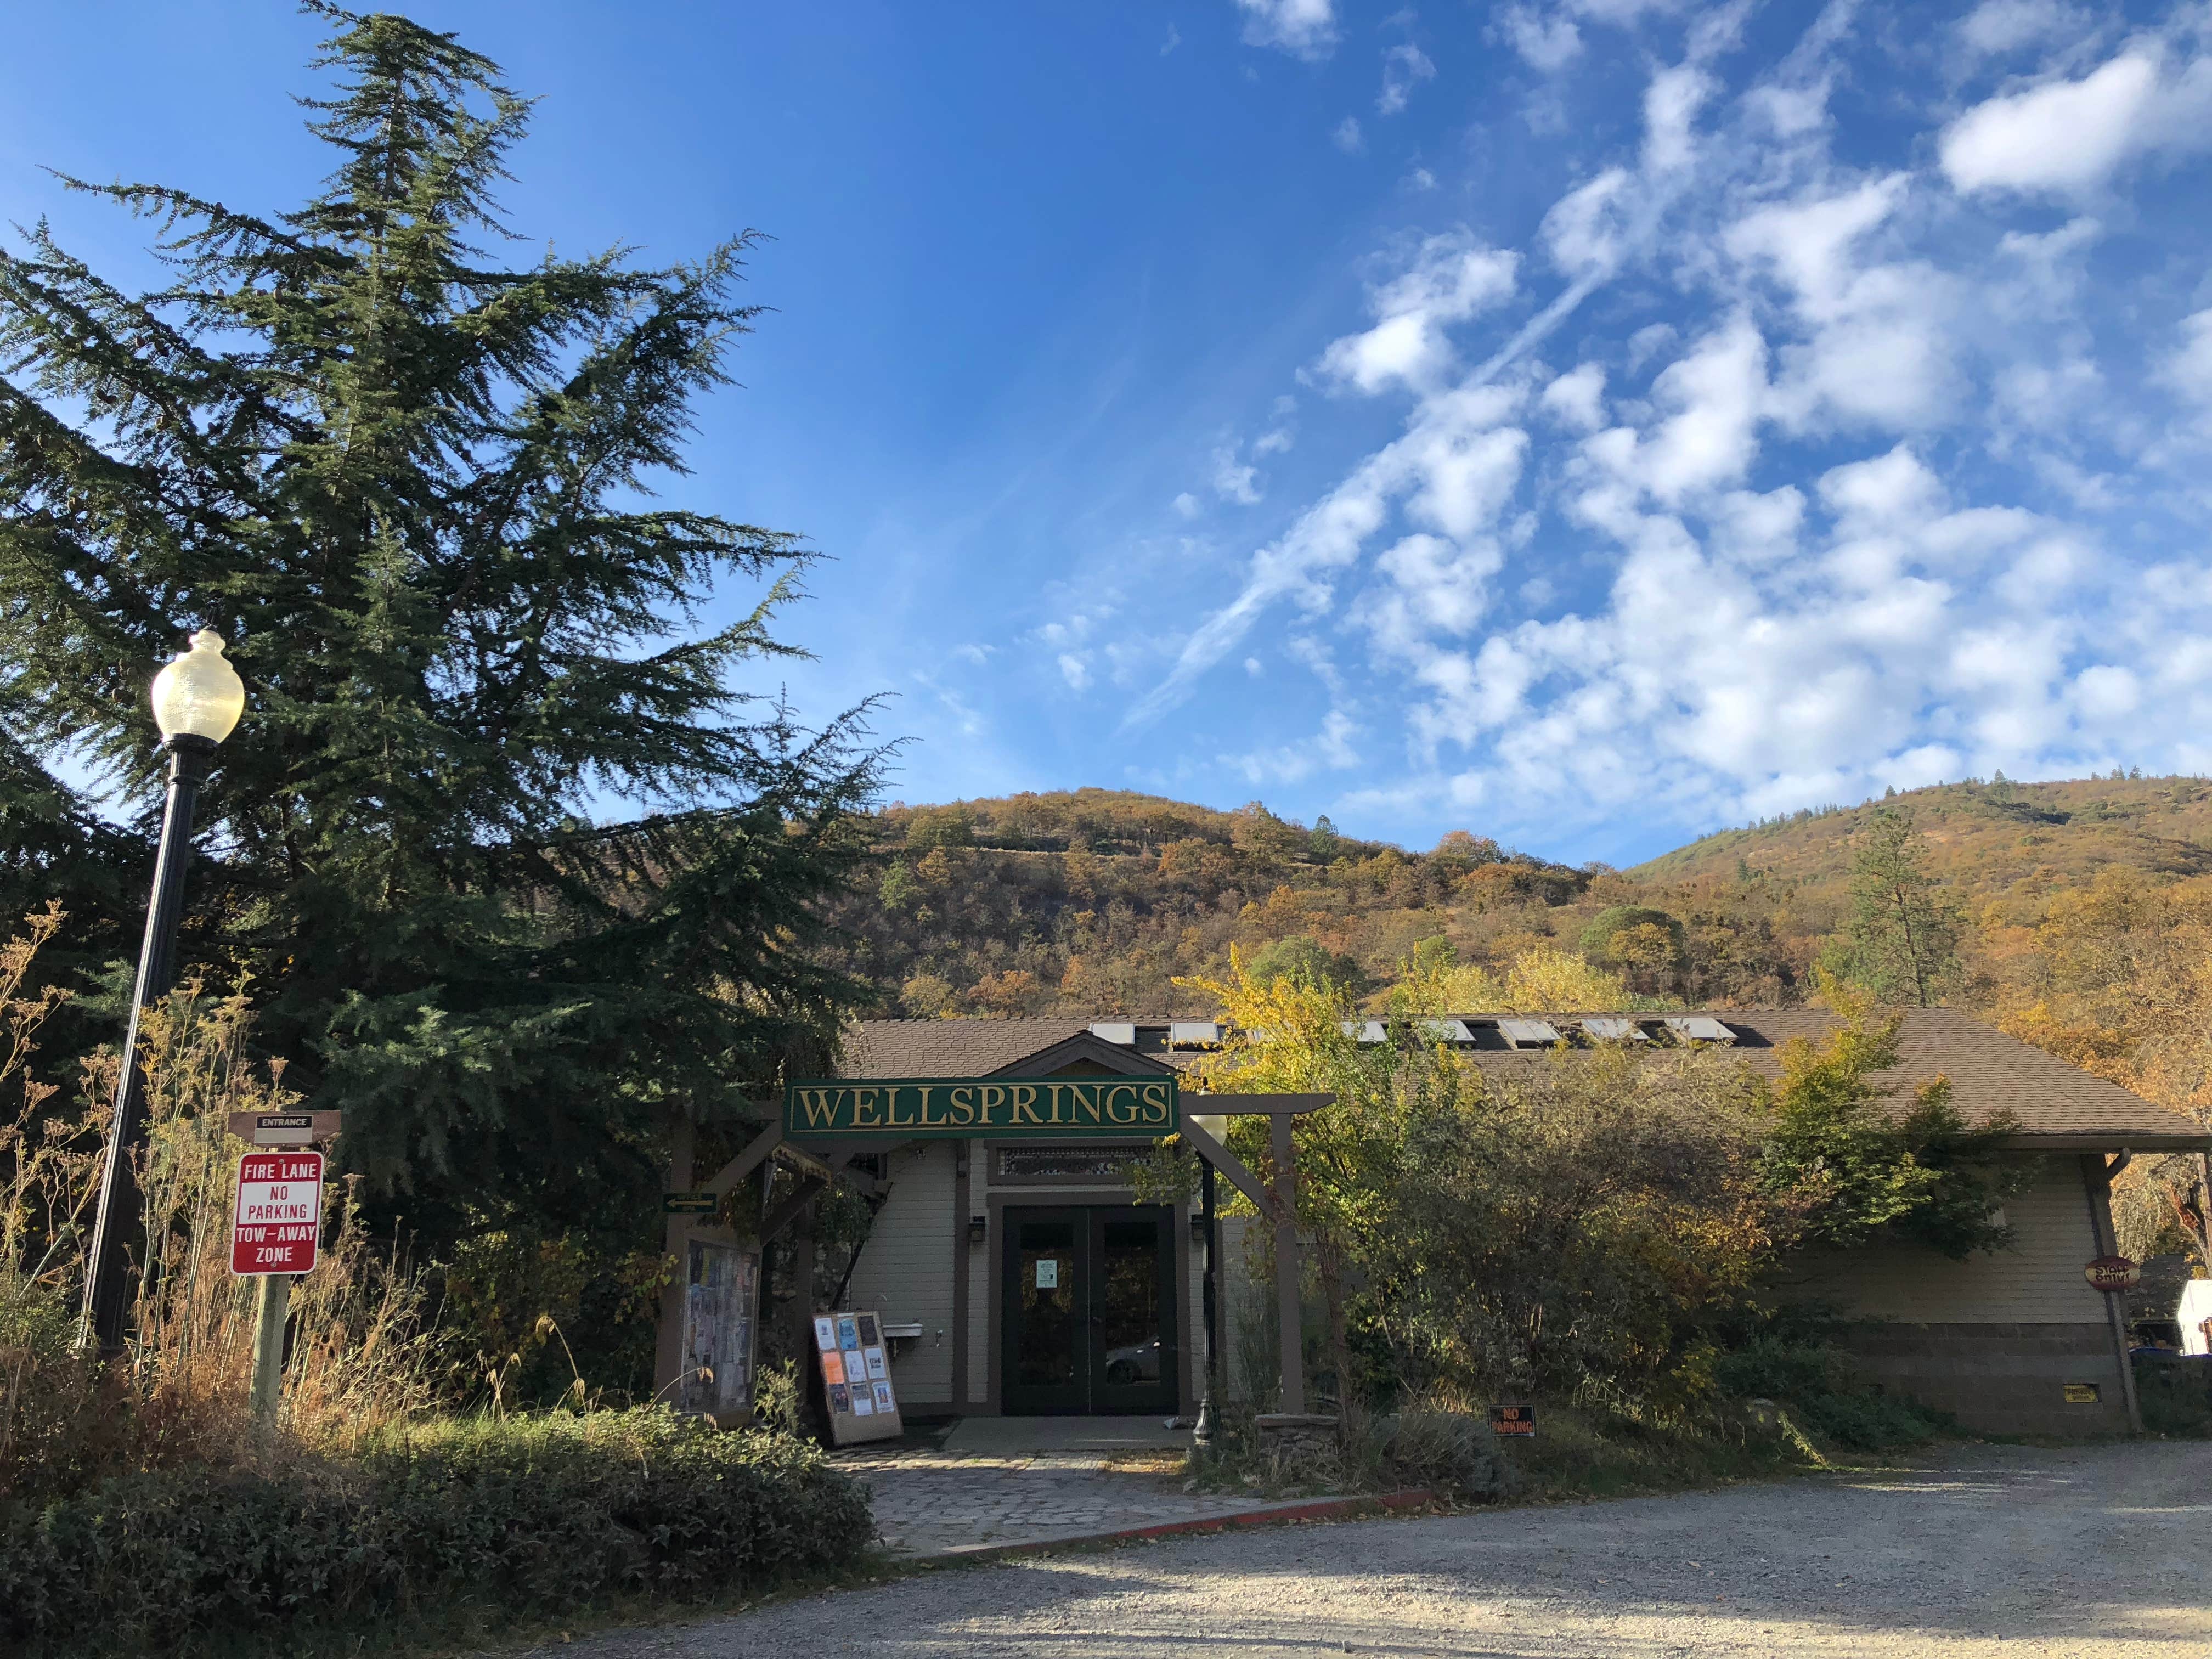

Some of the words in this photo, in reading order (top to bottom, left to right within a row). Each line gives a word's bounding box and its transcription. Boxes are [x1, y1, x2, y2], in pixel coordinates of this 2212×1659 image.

[799, 1085, 1167, 1127] WELLSPRINGS
[245, 1164, 274, 1179] FIRE
[281, 1163, 317, 1178] LANE
[270, 1186, 287, 1200] NO
[248, 1204, 307, 1220] PARKING
[236, 1226, 315, 1243] TOW-AWAY
[256, 1247, 292, 1262] ZONE
[1503, 1408, 1519, 1420] NO
[1492, 1421, 1533, 1433] PARKING
